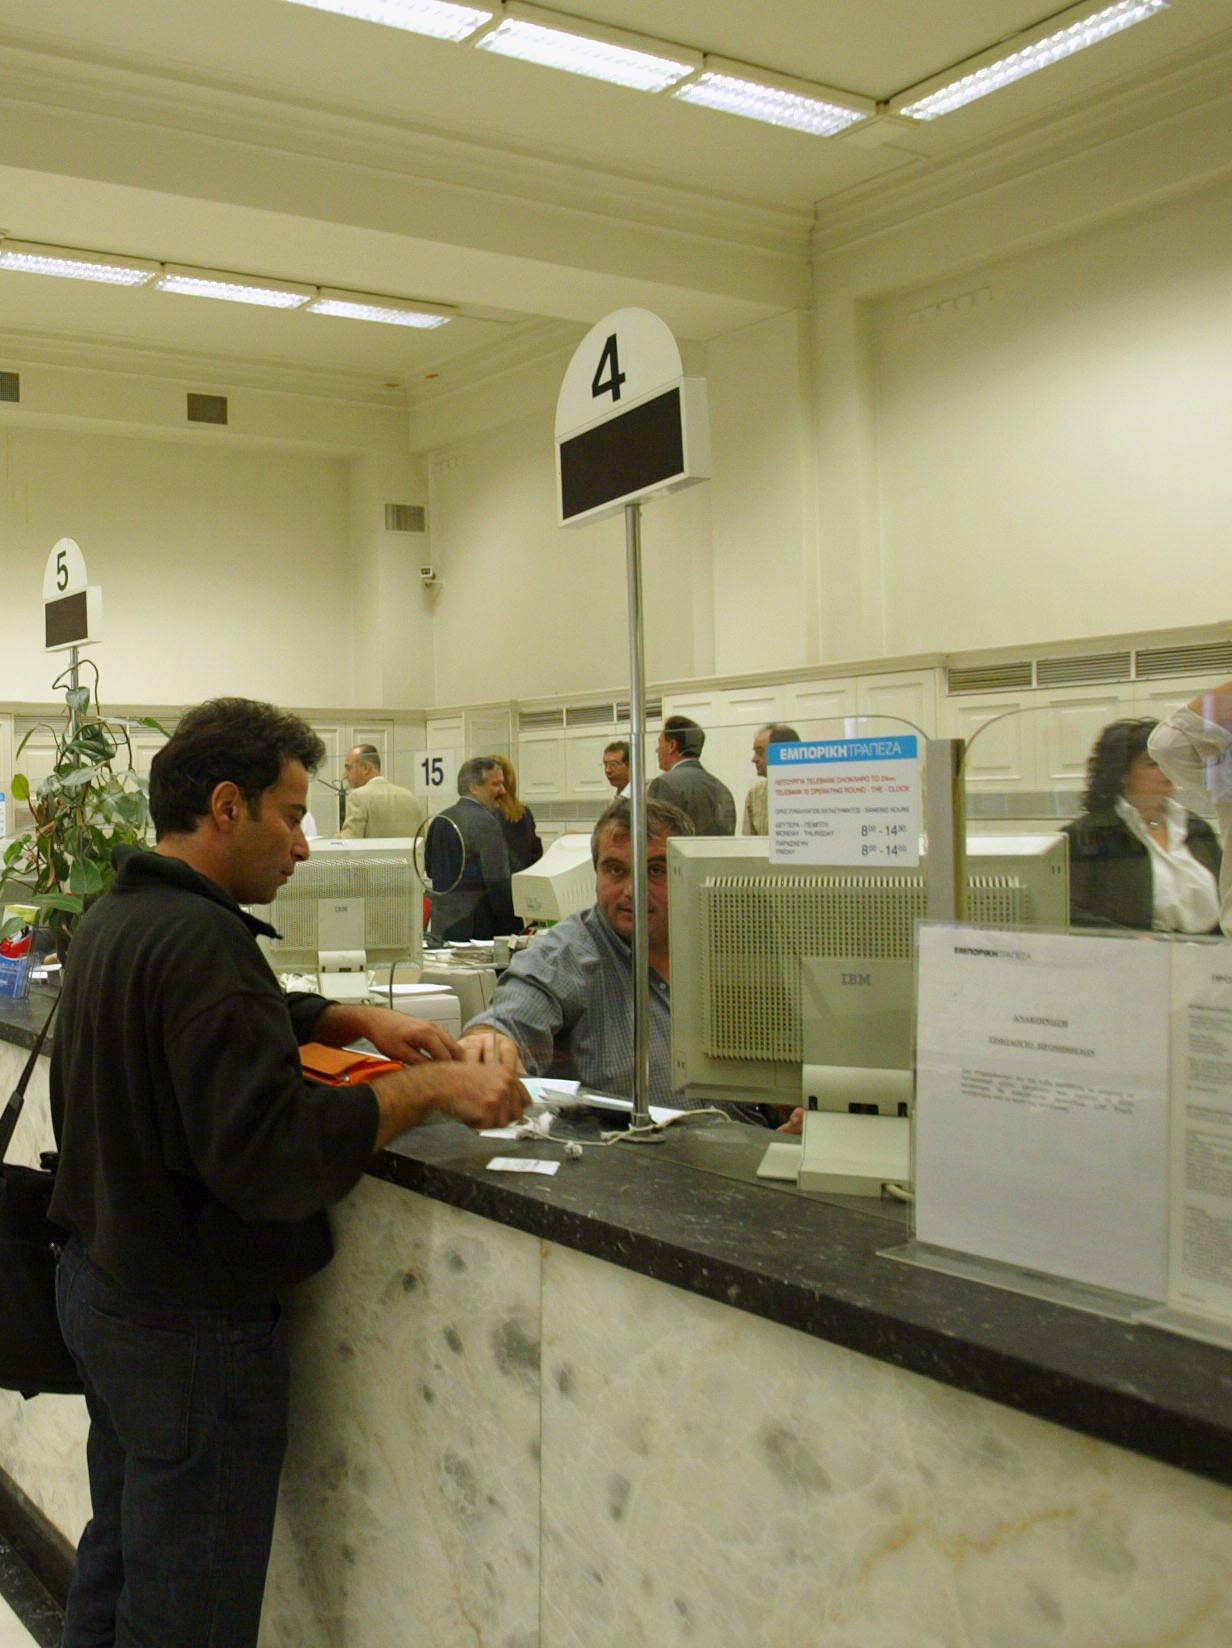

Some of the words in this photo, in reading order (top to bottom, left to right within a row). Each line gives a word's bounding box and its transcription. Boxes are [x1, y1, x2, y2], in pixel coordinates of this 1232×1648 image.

[592, 333, 626, 402] 4
[56, 550, 69, 592] 5
[421, 757, 444, 786] 15
[840, 972, 872, 987] IBM
